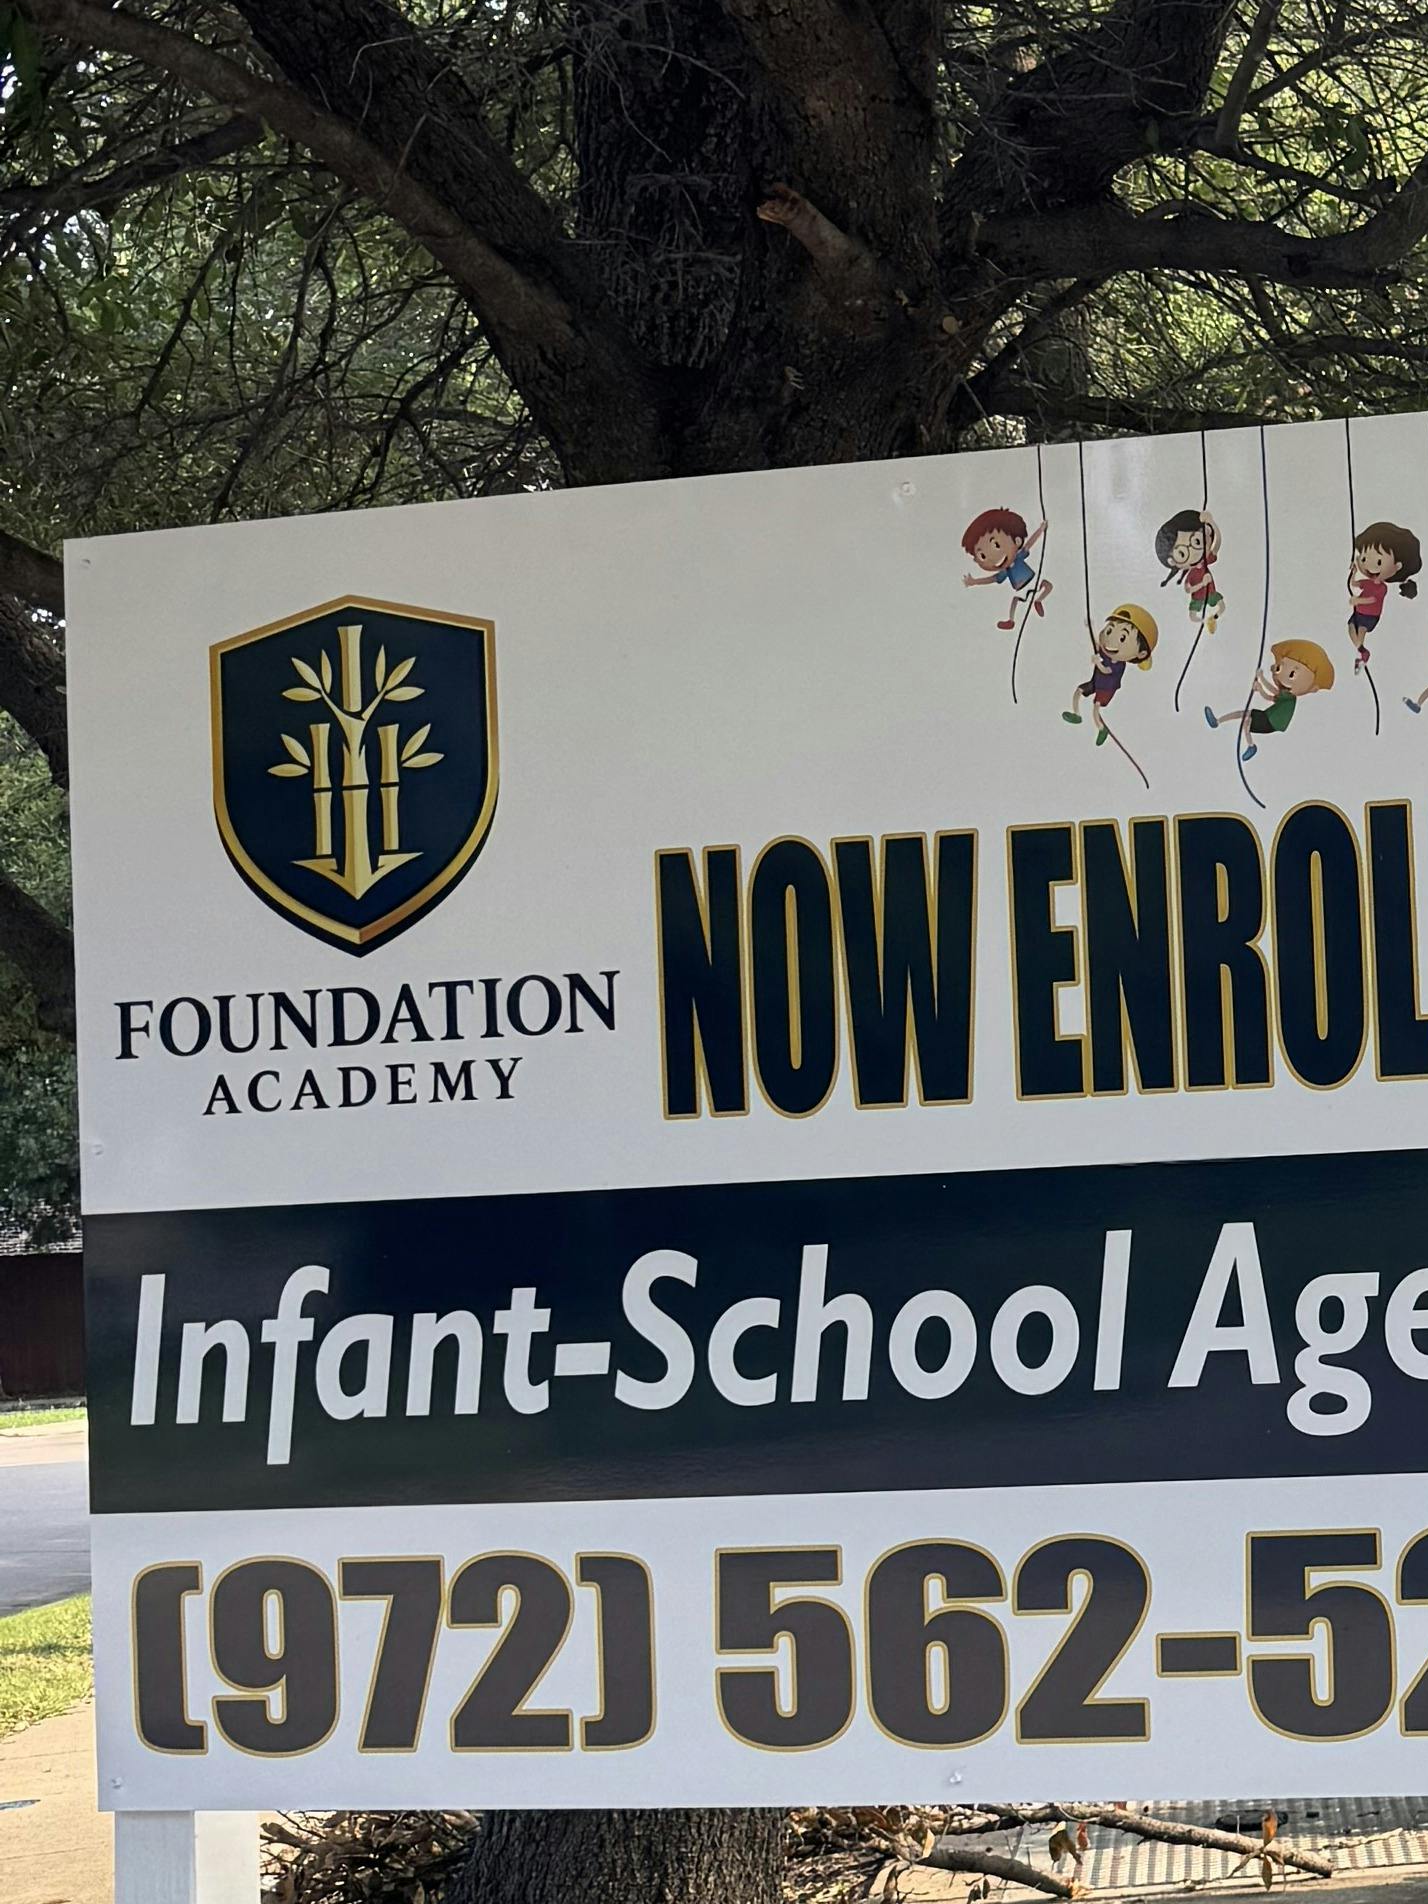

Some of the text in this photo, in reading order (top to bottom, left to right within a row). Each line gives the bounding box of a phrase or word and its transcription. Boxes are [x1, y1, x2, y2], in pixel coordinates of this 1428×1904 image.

[114, 970, 621, 1060] FOUNDATION
[655, 827, 979, 1120] NOW
[202, 1057, 523, 1116] ACADEMY
[129, 1227, 1132, 1466] Infant-School
[131, 1549, 658, 1758] (972)
